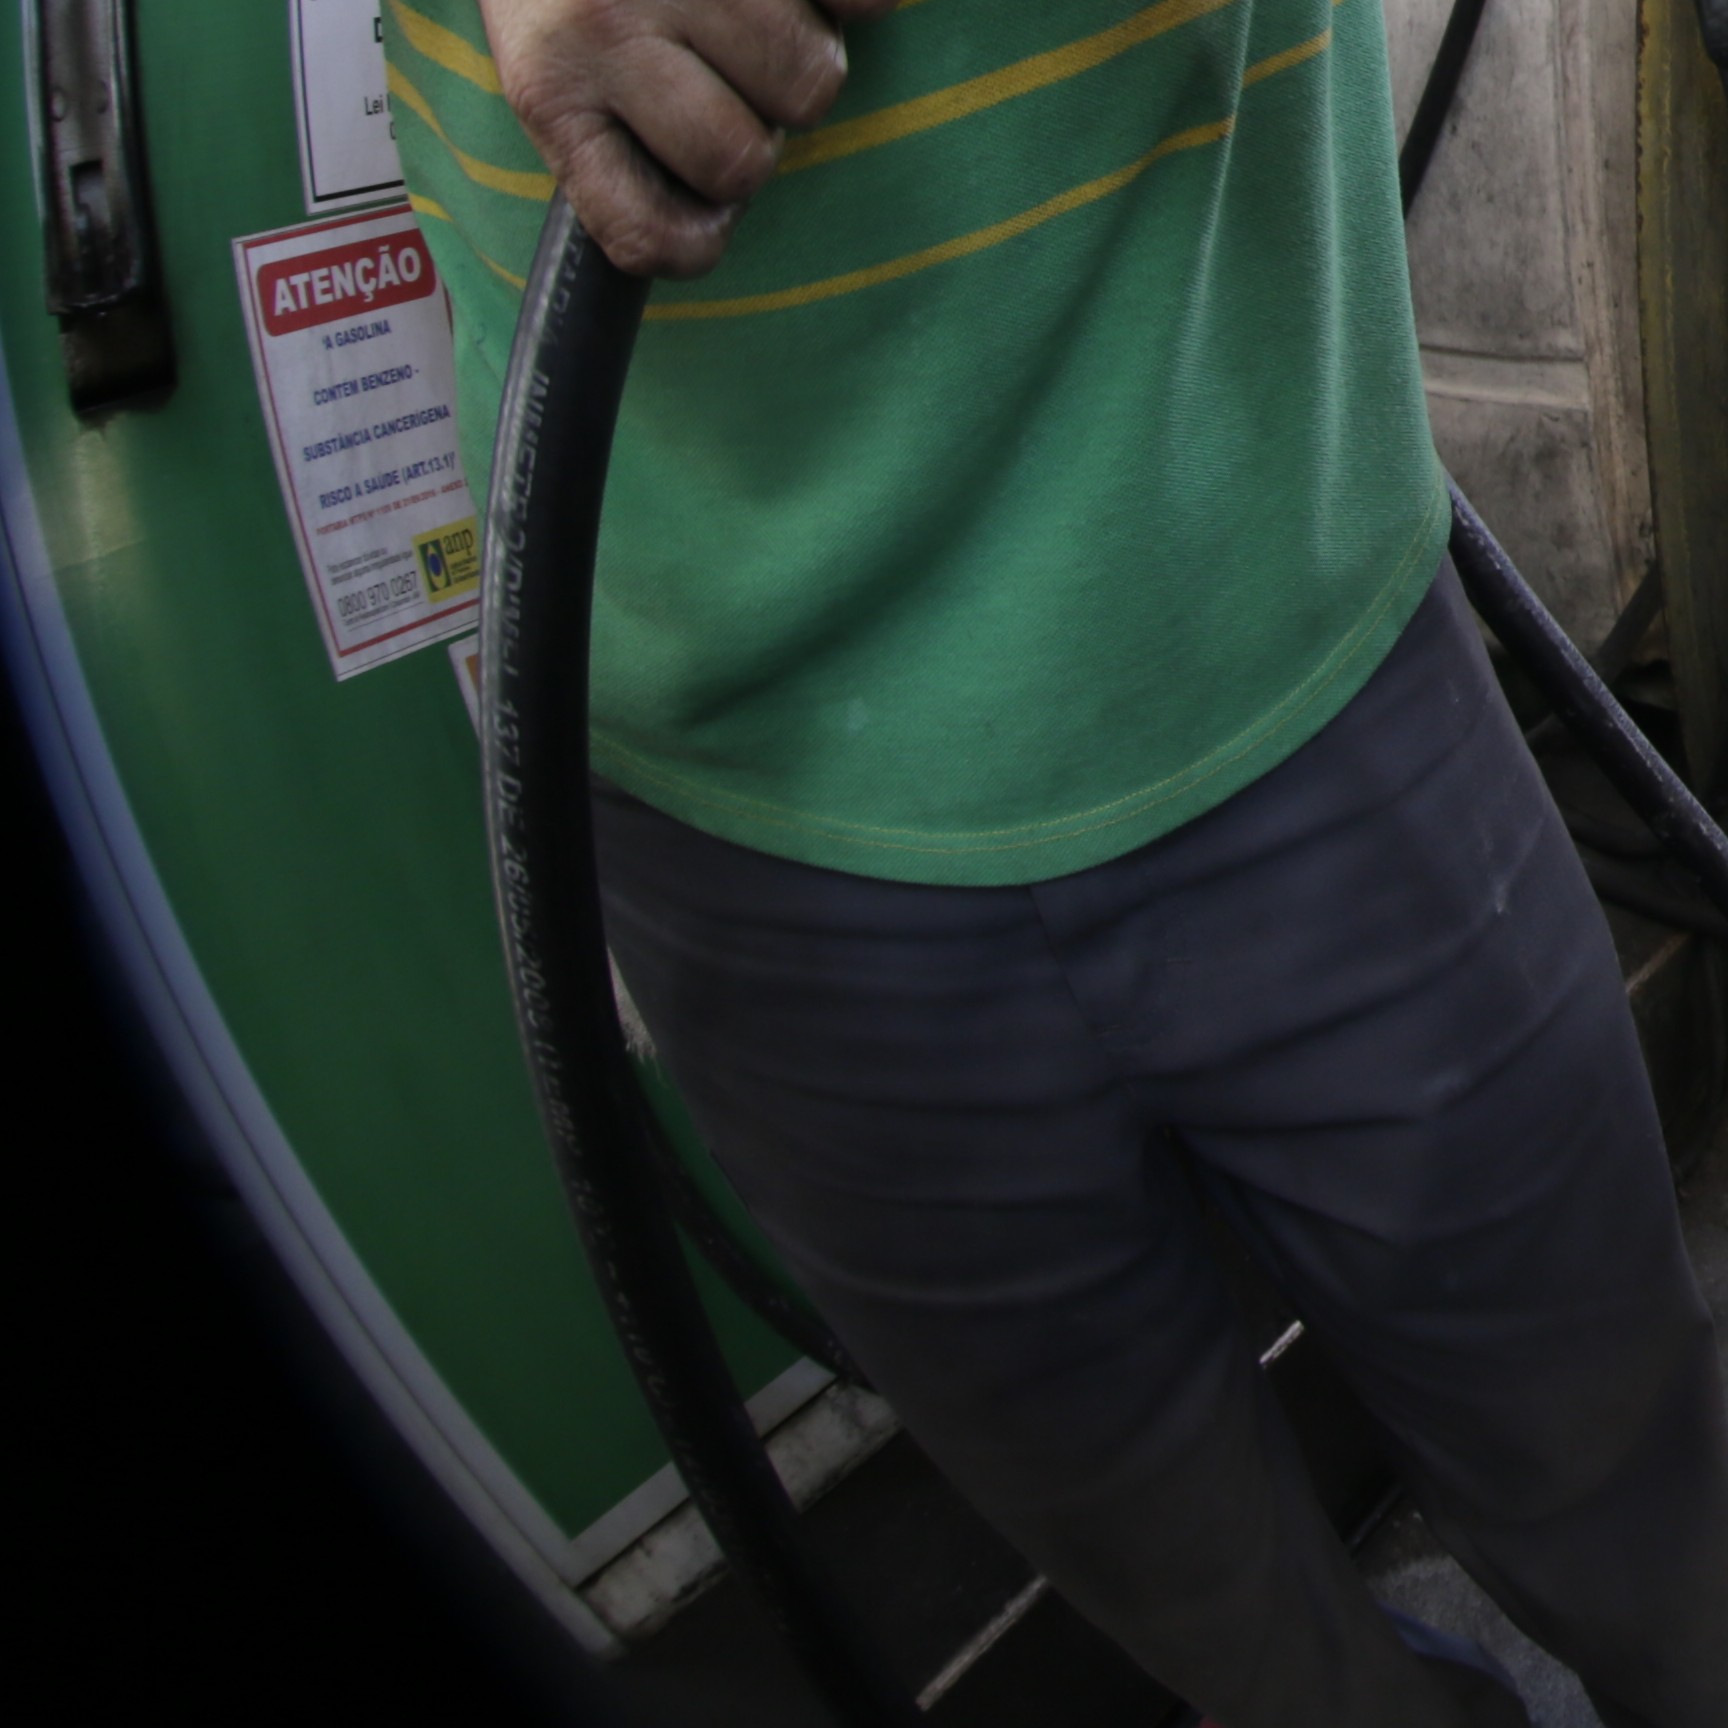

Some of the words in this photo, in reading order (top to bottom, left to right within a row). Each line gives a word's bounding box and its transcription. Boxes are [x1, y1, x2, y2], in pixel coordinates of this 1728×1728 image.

[365, 96, 384, 116] Lei
[274, 245, 422, 316] ATENÇÃO
[335, 319, 392, 348] GASOLINA
[313, 378, 360, 406] CONTÉM
[361, 364, 413, 392] BENZENO
[303, 429, 373, 472] SUBSTÂNCIA
[373, 404, 451, 440] CANCERÍGENA
[319, 488, 354, 510] RISCO
[443, 528, 474, 556] anp
[337, 592, 366, 617] 0800
[367, 582, 390, 607] 970
[391, 571, 418, 600] 0267
